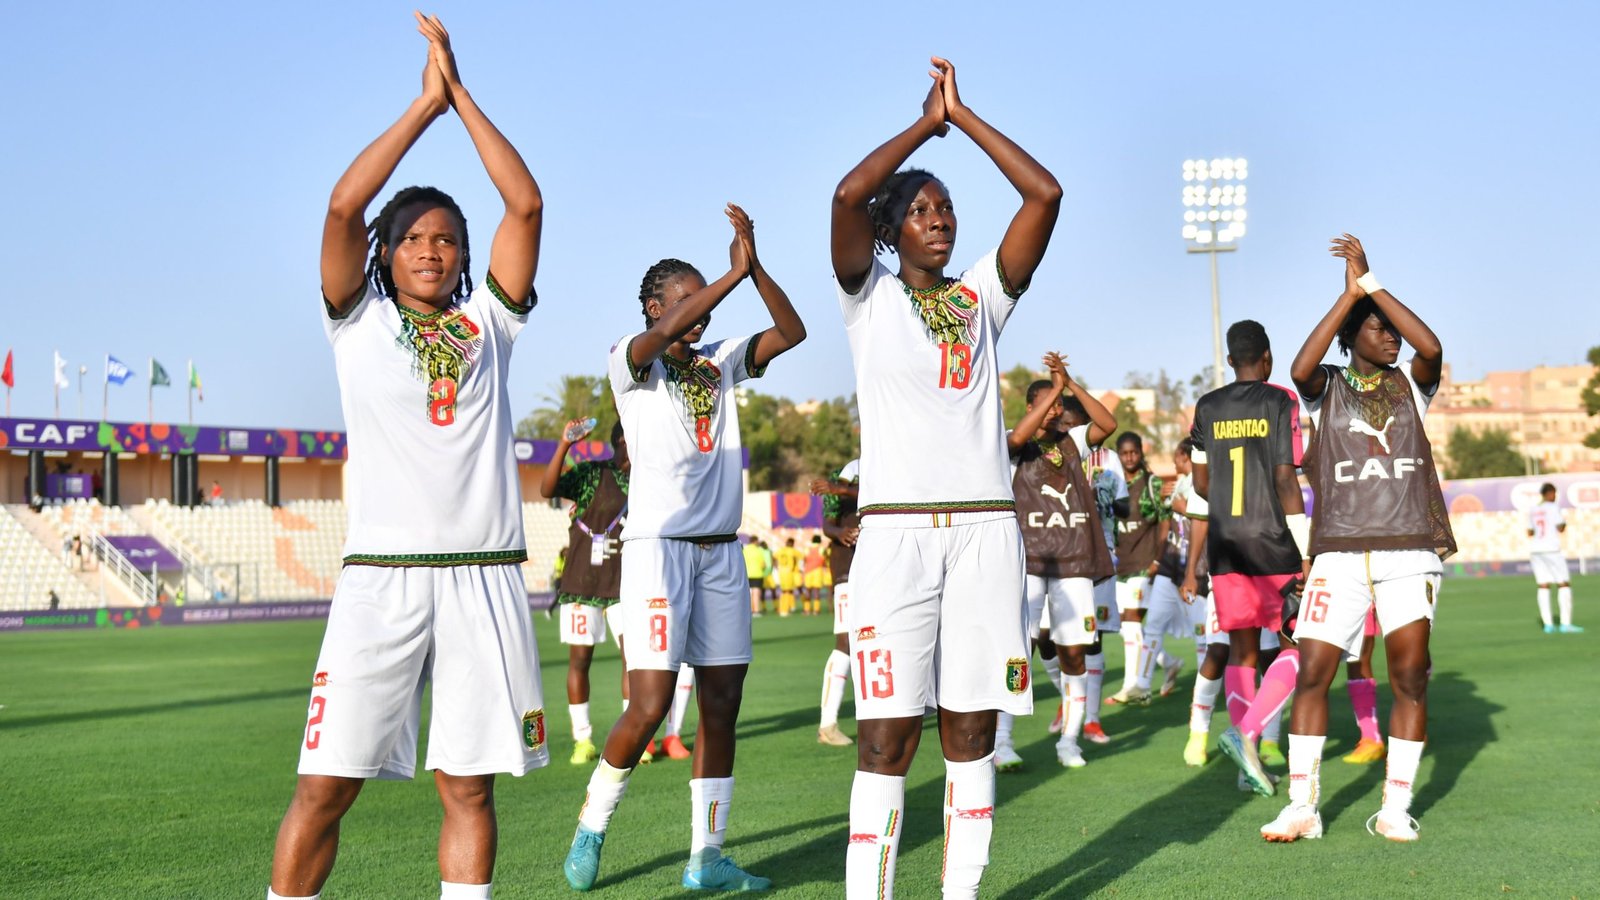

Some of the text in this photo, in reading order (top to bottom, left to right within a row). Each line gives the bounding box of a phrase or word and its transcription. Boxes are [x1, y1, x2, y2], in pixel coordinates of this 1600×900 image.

[938, 342, 972, 390] 13
[431, 378, 455, 427] 2
[696, 416, 713, 453] 8
[1213, 418, 1268, 440] KARENTAO
[1229, 446, 1244, 516] 1
[1118, 521, 1138, 533] AF
[571, 613, 587, 635] 12
[1304, 590, 1331, 623] 15
[650, 614, 667, 652] 8
[857, 648, 894, 700] 13
[306, 695, 326, 750] 2
